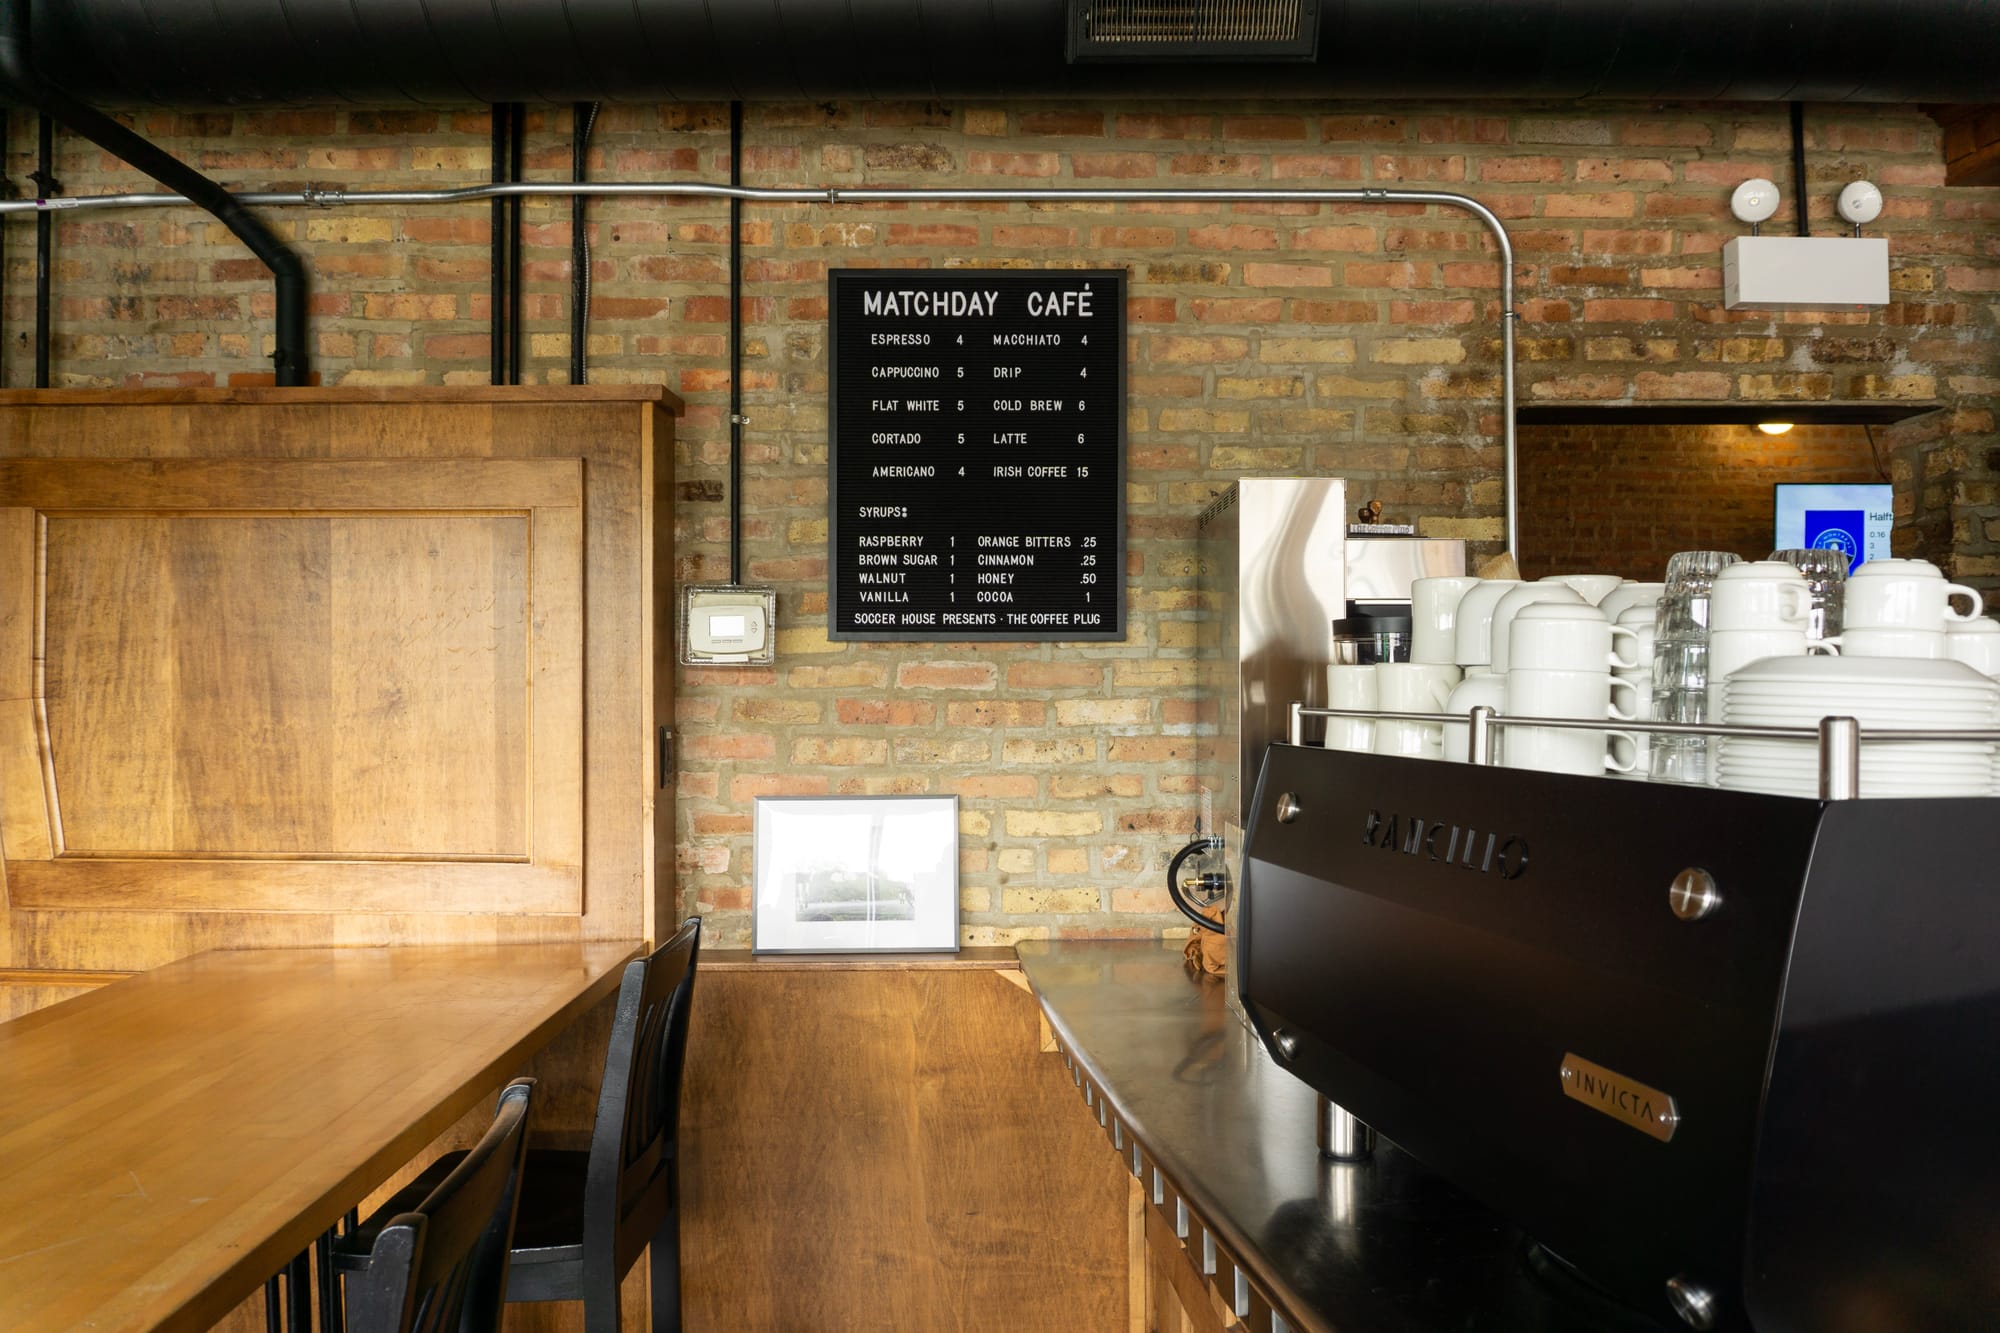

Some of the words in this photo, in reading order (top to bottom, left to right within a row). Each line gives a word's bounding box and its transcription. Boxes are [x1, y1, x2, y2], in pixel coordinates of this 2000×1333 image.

[864, 290, 999, 317] MATCHDAY
[1027, 282, 1094, 317] CAFÉ
[871, 333, 931, 345] ESPRESSO
[955, 334, 964, 346] 4
[993, 334, 1061, 346] MACCHIATO
[1080, 335, 1088, 346] 4
[871, 366, 940, 378] CAPPUCCINO
[956, 366, 964, 378] 5
[993, 366, 1022, 378] DRIP
[1079, 367, 1087, 379] 4
[872, 399, 899, 411] FLAT
[906, 399, 940, 412] WHITE
[956, 400, 964, 412] 5
[993, 399, 1022, 411] COLD
[1030, 399, 1063, 411] BREW
[1078, 400, 1086, 411] 6
[871, 432, 921, 445] CORTADO
[957, 433, 965, 445] 5
[993, 432, 1028, 444] LATTE
[1077, 433, 1085, 444] 6
[871, 465, 935, 478] AMERICANO
[957, 466, 965, 477] 4
[993, 465, 1022, 477] IRISH
[1027, 465, 1067, 478] COFFEE
[1076, 466, 1089, 478] 15
[859, 506, 908, 518] SYRUPS:
[859, 535, 924, 547] RASPBERRY
[977, 535, 1020, 548] ORANGE
[1025, 536, 1072, 548] BITTERS
[1080, 536, 1097, 548] .25
[858, 553, 898, 566] BROWN
[902, 554, 938, 566] SUGAR
[977, 554, 1034, 566] CINNAMON
[1080, 554, 1096, 566] .25
[858, 572, 906, 584] WALNUT
[977, 572, 1015, 585] HONEY
[1079, 572, 1097, 585] .50
[859, 591, 909, 603] VANILLA
[976, 591, 1014, 603] COCOA
[854, 612, 896, 625] SOCCER
[901, 613, 936, 625] HOUSE
[942, 613, 997, 625] PRESENTS
[1006, 613, 1028, 625] THE
[1029, 613, 1069, 625] COFFEE
[1073, 613, 1101, 625] PLUG
[1362, 808, 1530, 880] RANCILIO
[1575, 1069, 1655, 1123] INVICTA
